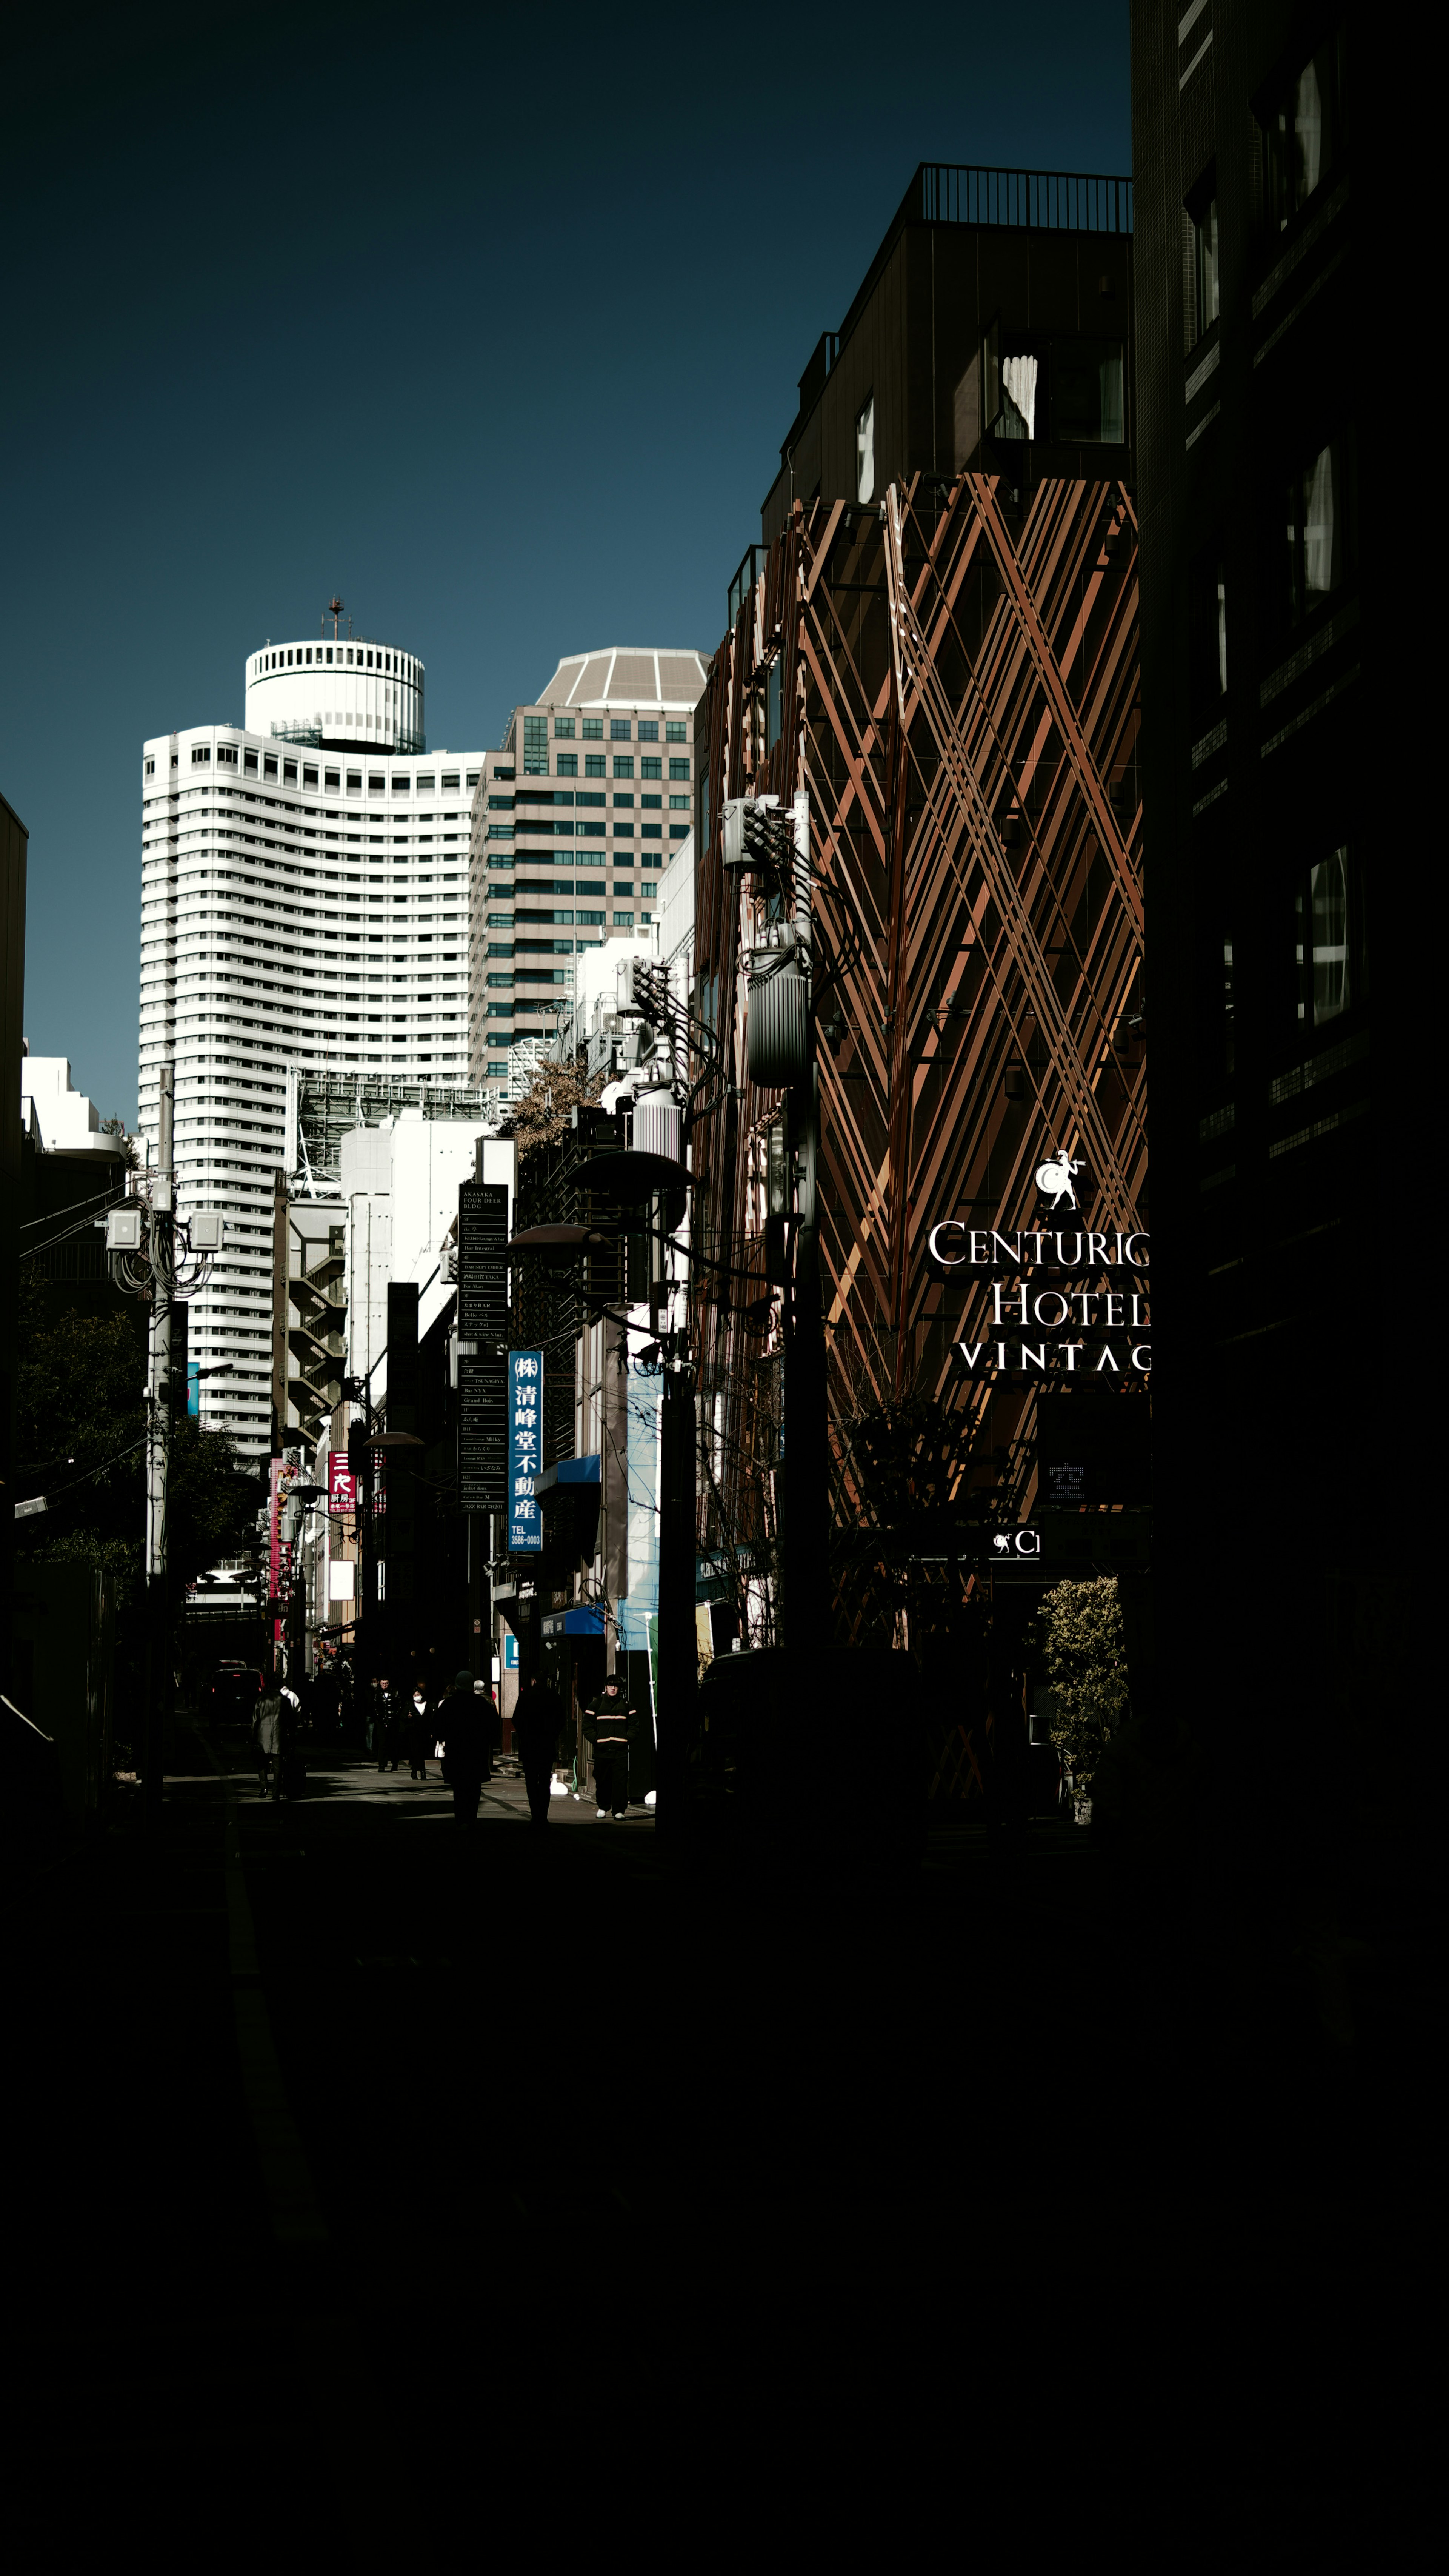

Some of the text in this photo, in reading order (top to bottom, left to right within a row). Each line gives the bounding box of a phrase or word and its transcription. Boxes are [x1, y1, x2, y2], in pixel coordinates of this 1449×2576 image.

[991, 1283, 1151, 1327] HOTEL
[959, 1342, 1152, 1372] VINTAG
[1049, 1462, 1085, 1498] 空
[511, 1526, 526, 1534] TEL
[511, 1535, 540, 1545] 3586-0003
